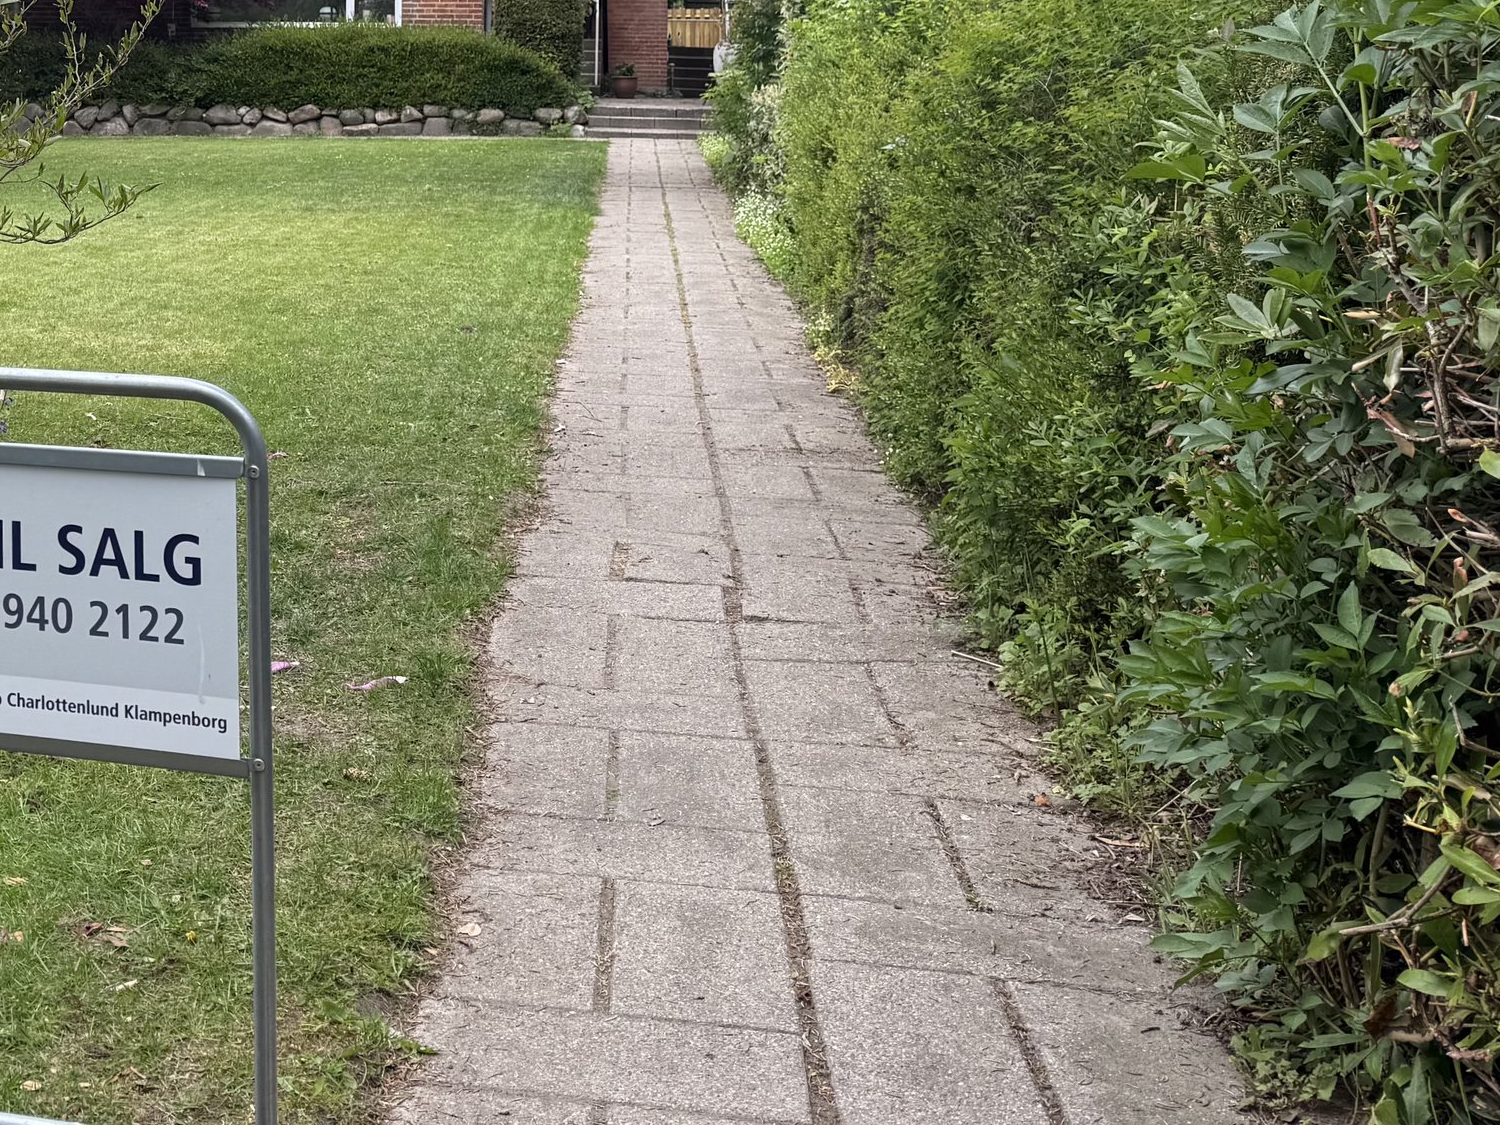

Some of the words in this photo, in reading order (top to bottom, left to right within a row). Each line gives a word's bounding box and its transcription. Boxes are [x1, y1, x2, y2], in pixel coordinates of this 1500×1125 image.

[57, 524, 202, 586] SALG
[89, 600, 185, 645] 2122
[7, 692, 119, 718] Charlottenlund
[124, 704, 228, 734] Klampenborg
